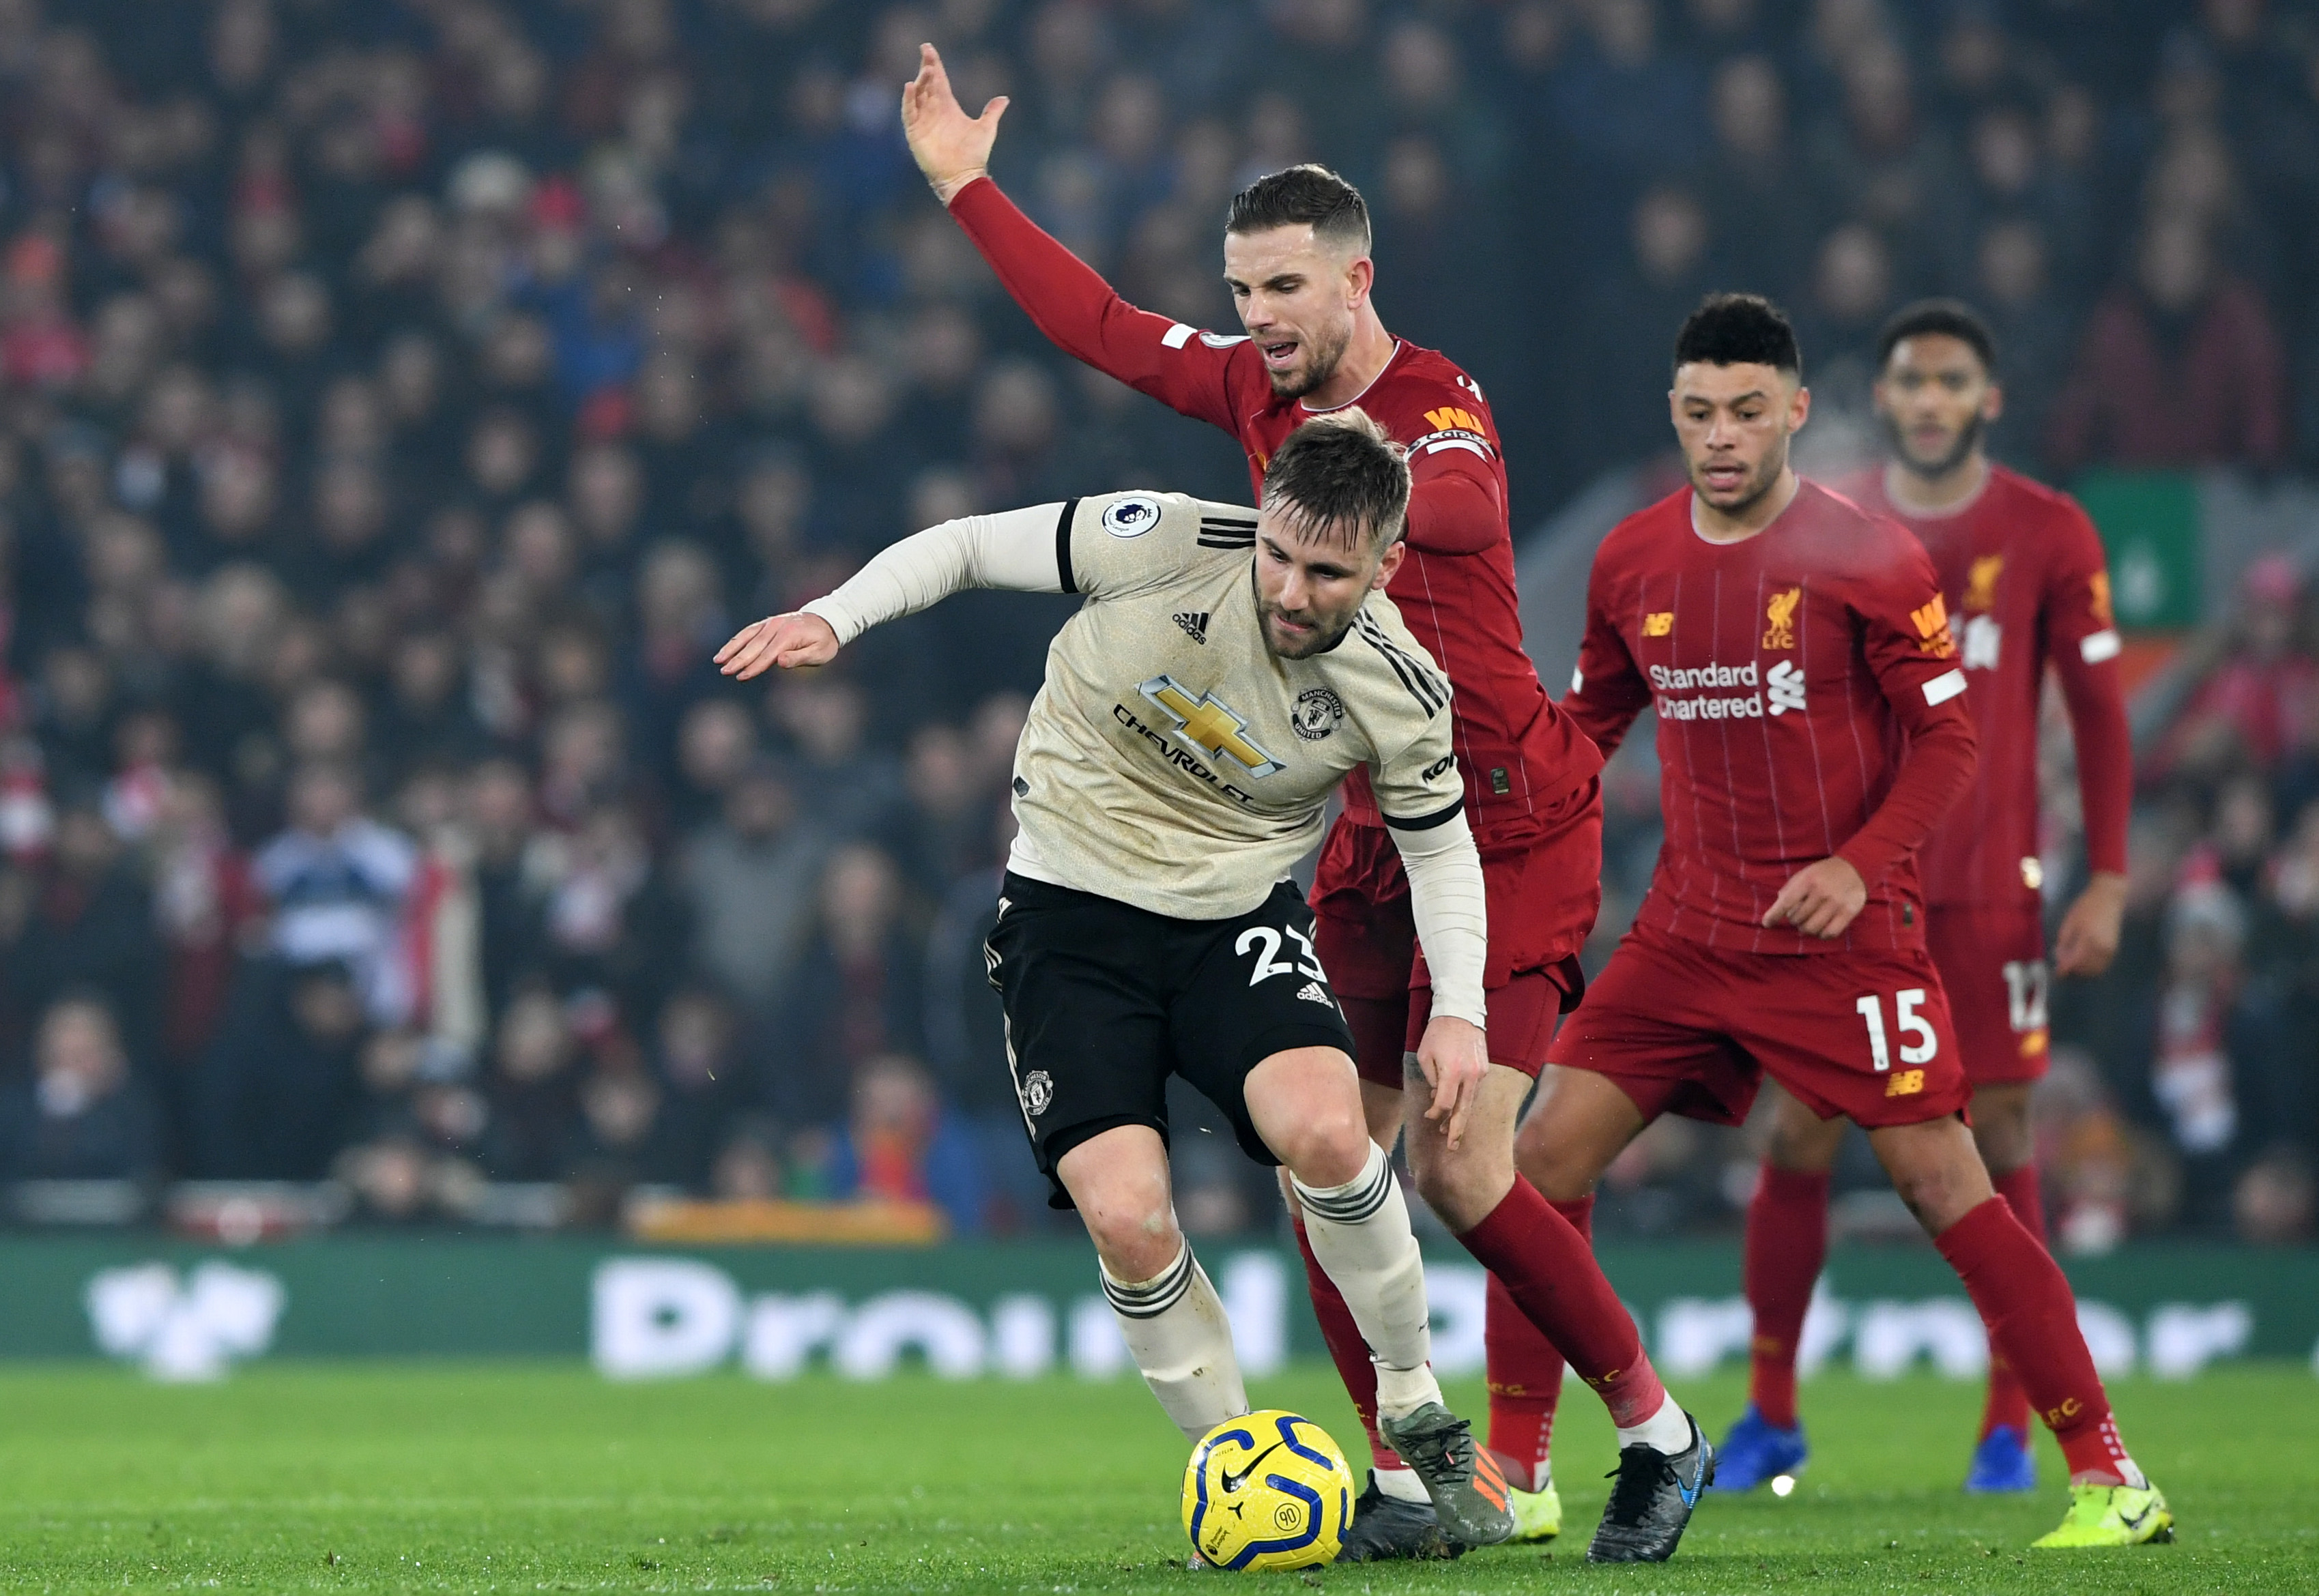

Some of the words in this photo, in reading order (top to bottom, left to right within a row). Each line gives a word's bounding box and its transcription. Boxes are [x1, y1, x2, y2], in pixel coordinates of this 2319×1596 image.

[1172, 613, 1207, 645] adidas
[1649, 660, 1759, 691] Standard
[1301, 690, 1341, 717] MANCHESTER
[1656, 691, 1763, 721] Chartered
[1295, 722, 1322, 738] UNITED
[1113, 703, 1254, 803] CHEVROLET
[1235, 923, 1328, 987] 23
[1296, 991, 1334, 1009] adidas
[1856, 988, 1938, 1071] 15
[1279, 1507, 1297, 1526] 90
